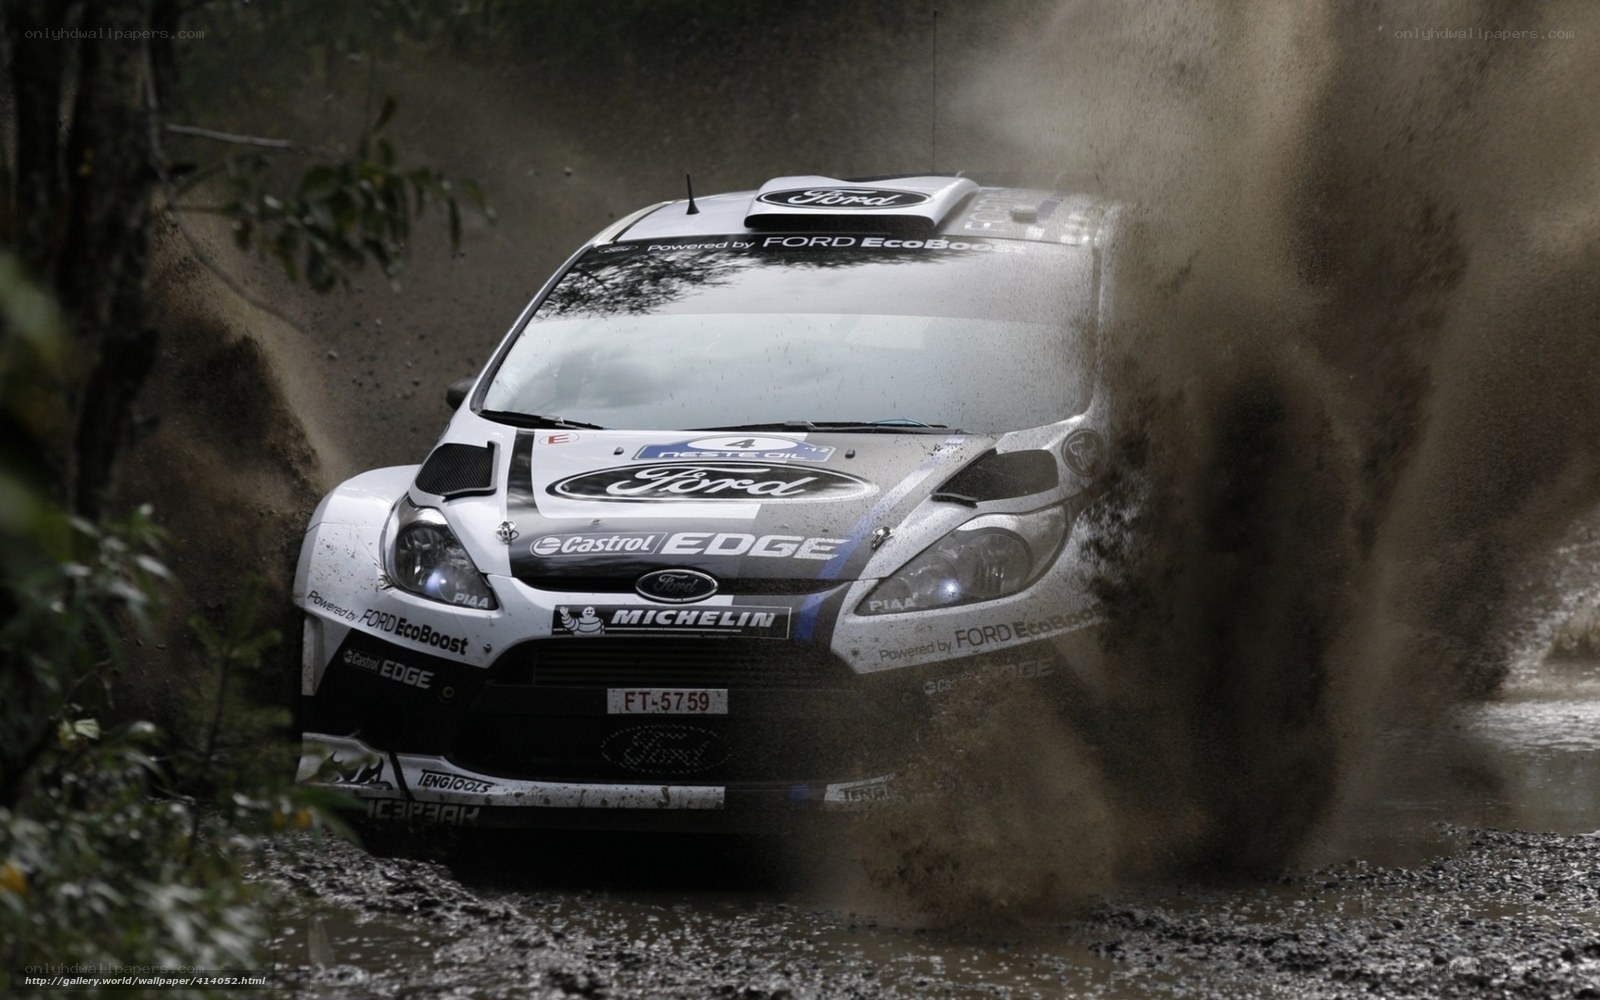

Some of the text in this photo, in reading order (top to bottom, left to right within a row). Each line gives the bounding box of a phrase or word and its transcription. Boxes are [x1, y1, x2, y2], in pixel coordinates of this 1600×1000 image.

[787, 189, 897, 207] Ford
[647, 236, 1024, 252] Powered by FORD EcoBoo
[725, 439, 755, 448] 4
[606, 467, 818, 496] Ford
[561, 532, 851, 560] Castrol EDGE
[653, 574, 699, 593] Ford
[453, 593, 489, 608] PIAA
[869, 598, 916, 611] PIAA
[307, 590, 469, 655] Powered by FORD EcoBoost
[610, 610, 775, 628] MICHELIN
[880, 641, 934, 662] Powered
[936, 639, 952, 652] by
[955, 624, 1012, 648] FORD
[352, 653, 435, 689] Castrol EDGE
[624, 691, 710, 712] FT-5759
